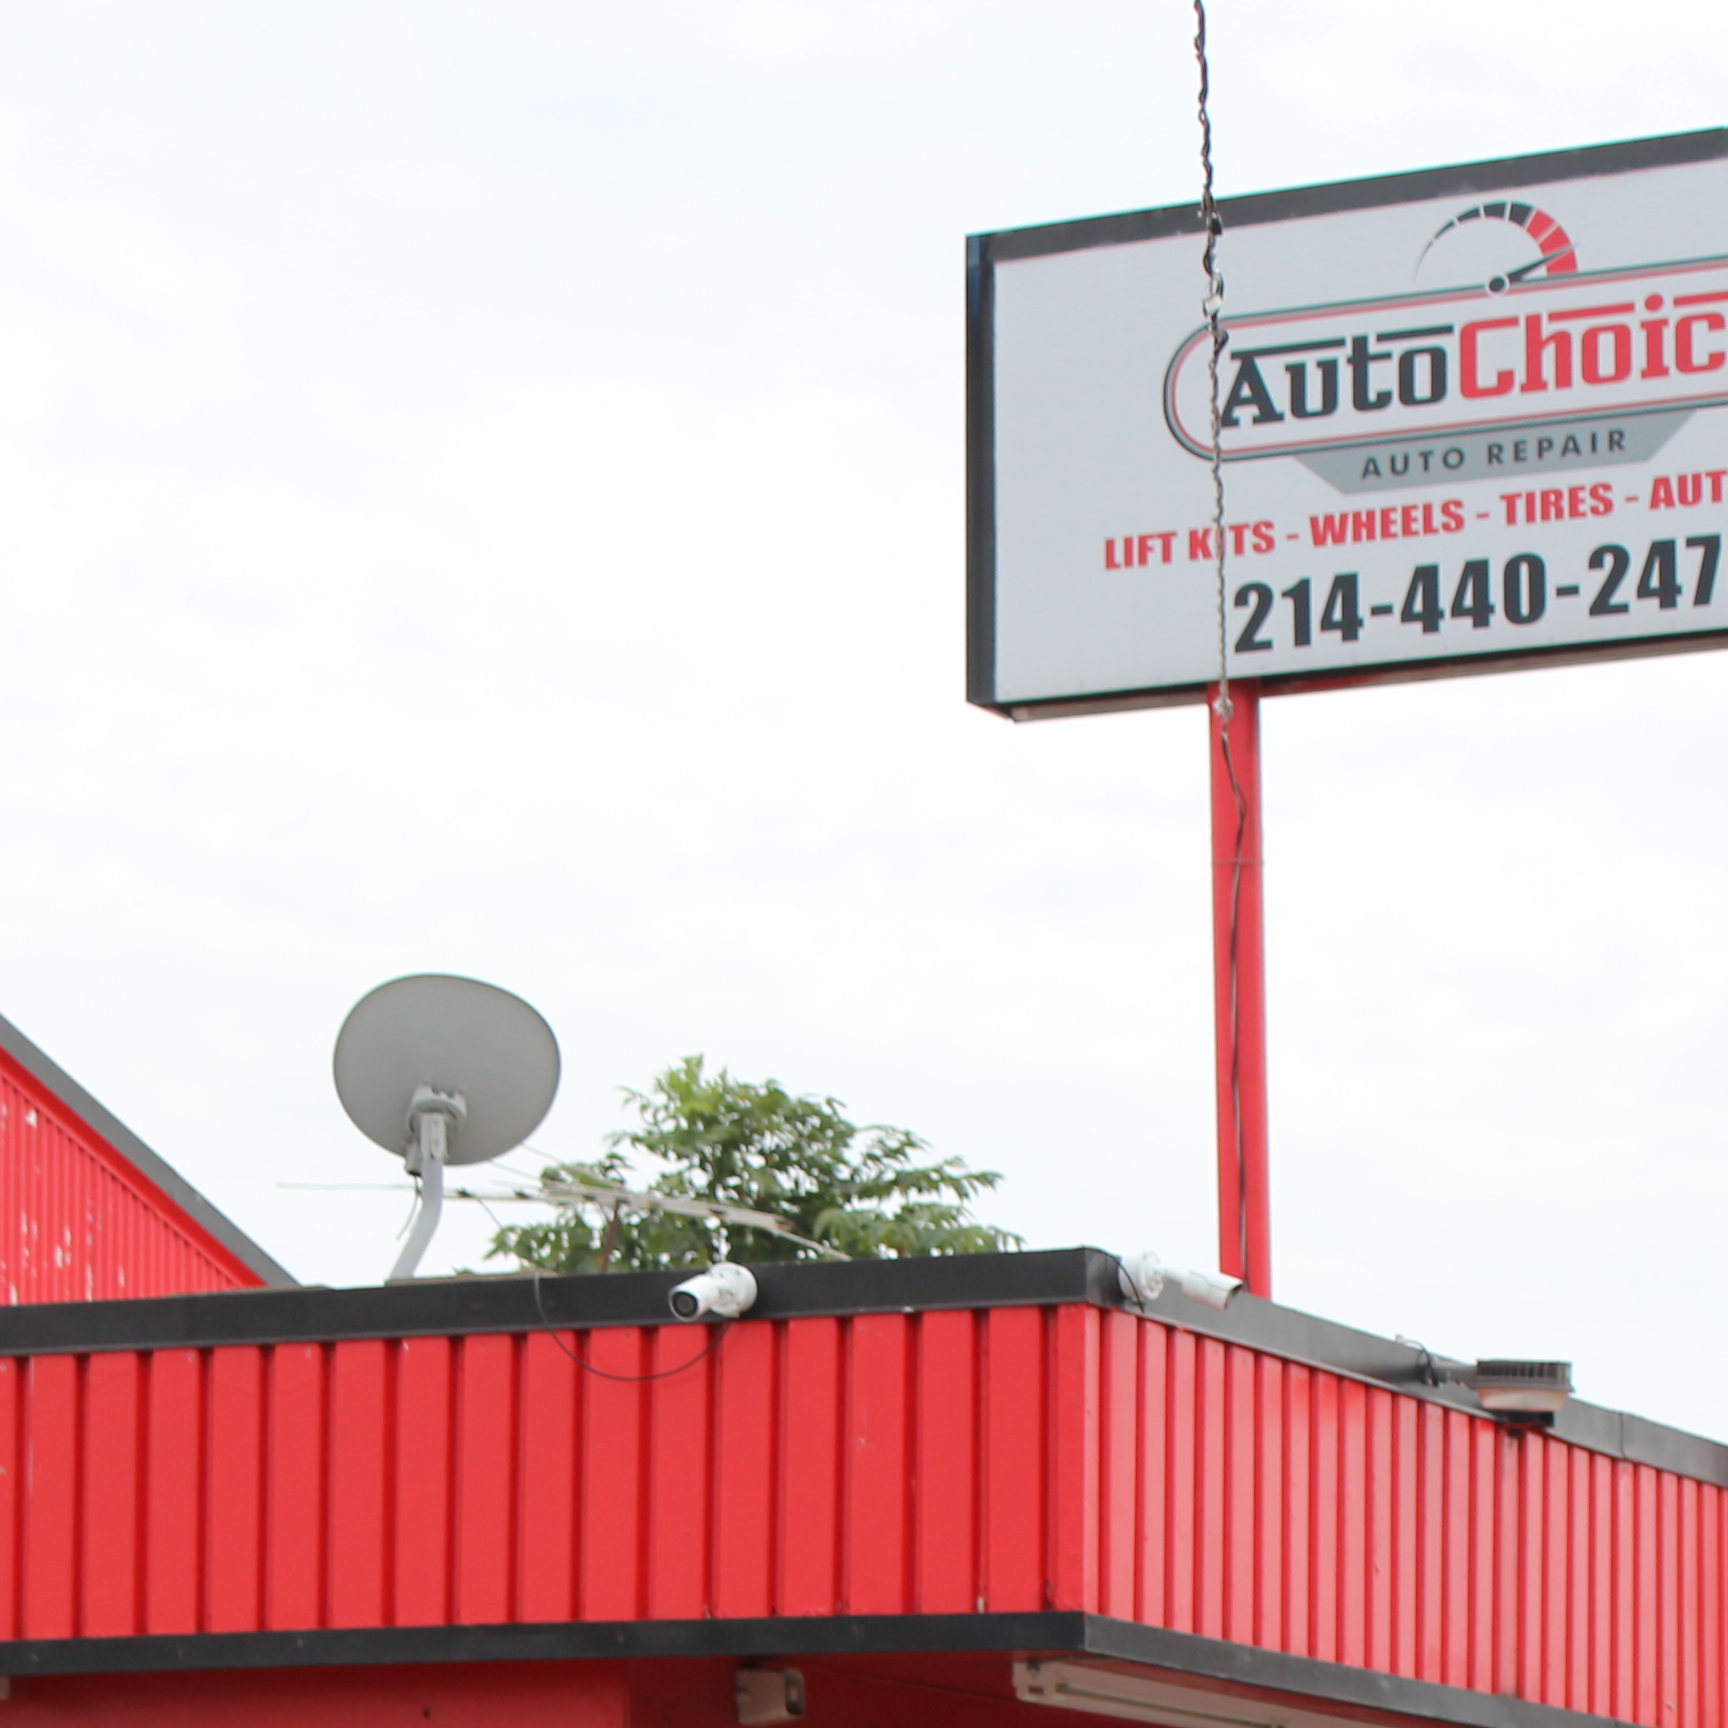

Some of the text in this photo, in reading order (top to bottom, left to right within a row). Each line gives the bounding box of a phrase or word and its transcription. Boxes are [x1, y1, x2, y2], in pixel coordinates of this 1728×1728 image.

[1360, 428, 1628, 480] AUTO REPAIR
[1104, 531, 1178, 570] LIFT
[1309, 498, 1466, 548] WHEELS
[1499, 482, 1615, 526] TIRES
